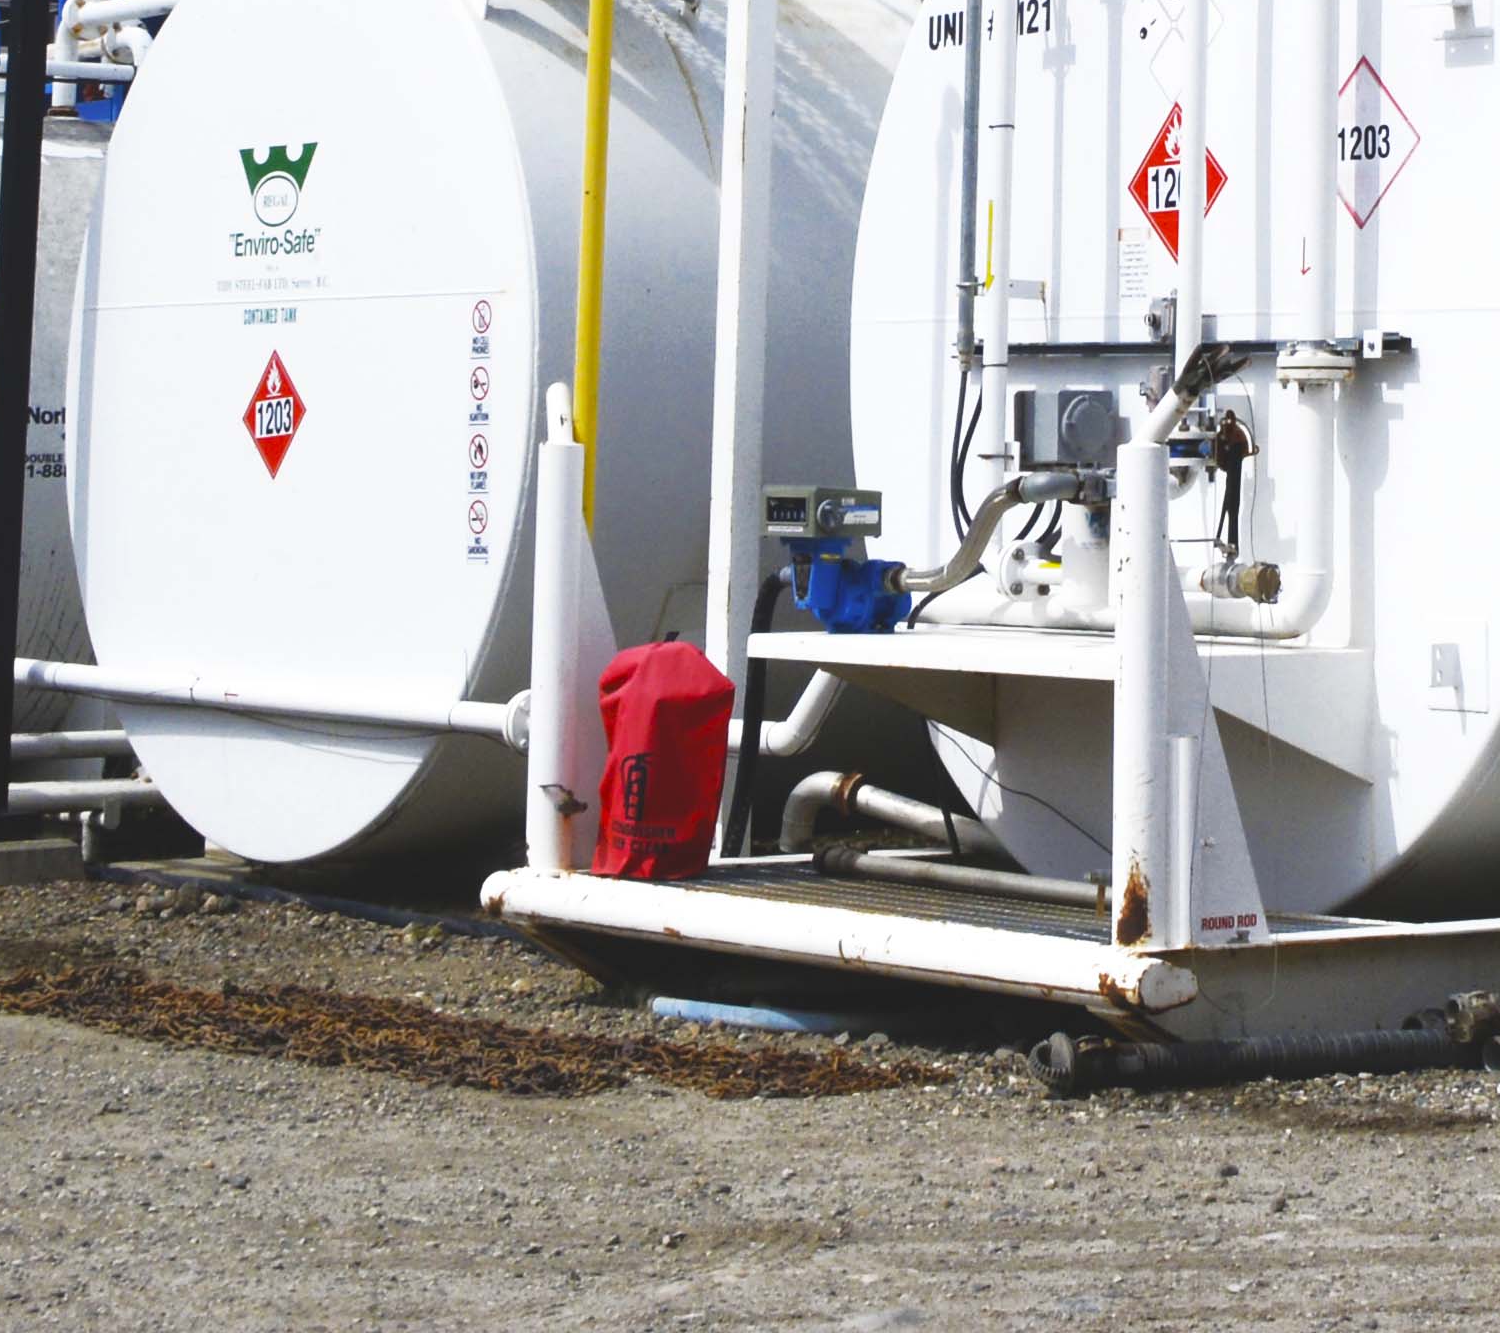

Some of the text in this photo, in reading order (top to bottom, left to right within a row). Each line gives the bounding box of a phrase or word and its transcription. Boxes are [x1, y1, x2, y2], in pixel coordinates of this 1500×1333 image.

[929, 10, 964, 51] UNI
[1337, 124, 1390, 161] 1203
[1151, 167, 1180, 210] 12
[257, 398, 292, 435] 1203
[26, 463, 67, 479] 1-88
[1201, 913, 1258, 931] ROUND ROD
